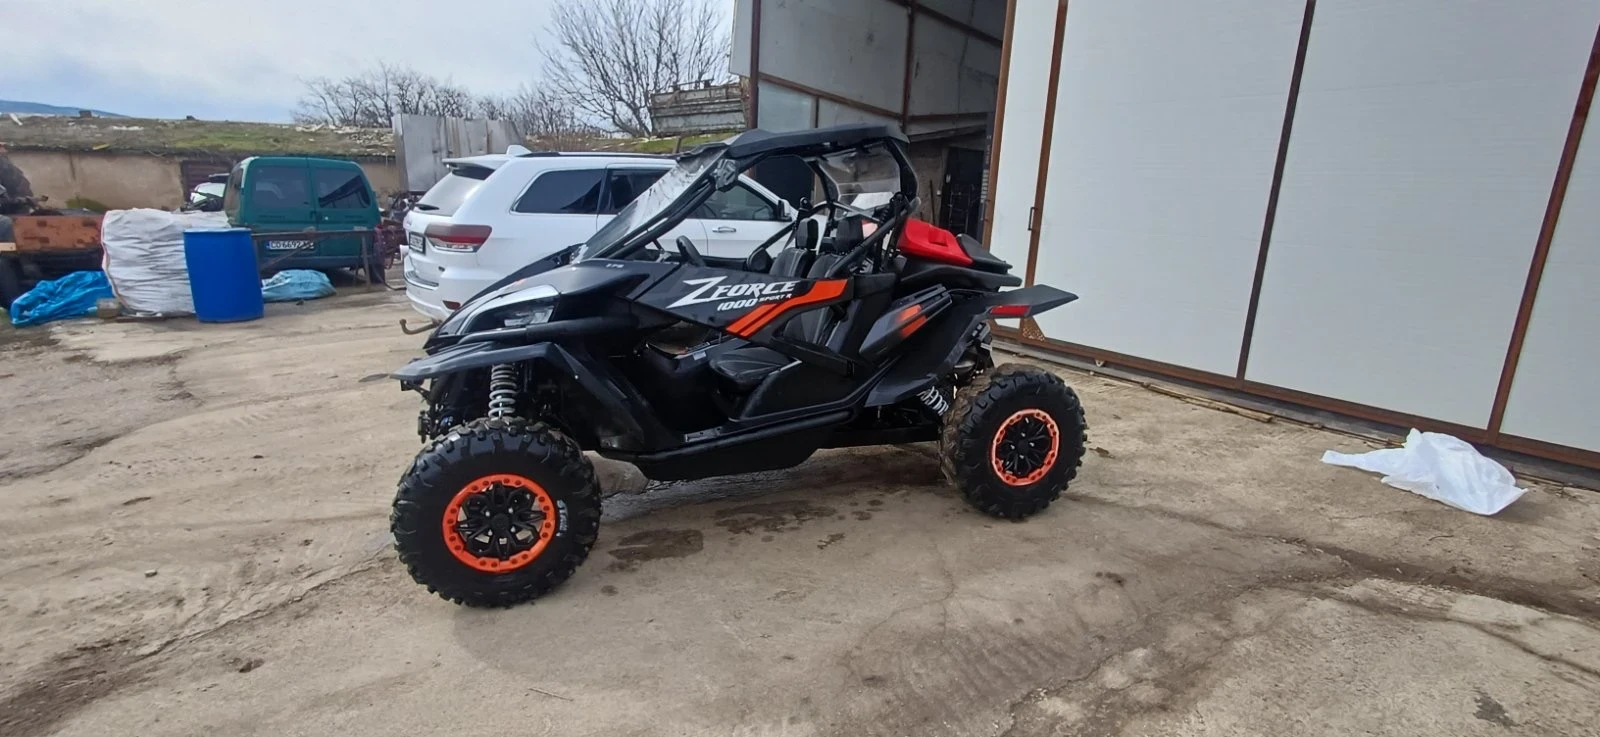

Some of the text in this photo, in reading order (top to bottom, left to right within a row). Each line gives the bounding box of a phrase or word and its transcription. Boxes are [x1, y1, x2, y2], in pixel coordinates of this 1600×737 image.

[665, 275, 801, 309] ZFORCE
[717, 298, 759, 311] 1000
[758, 294, 786, 303] SPORT
